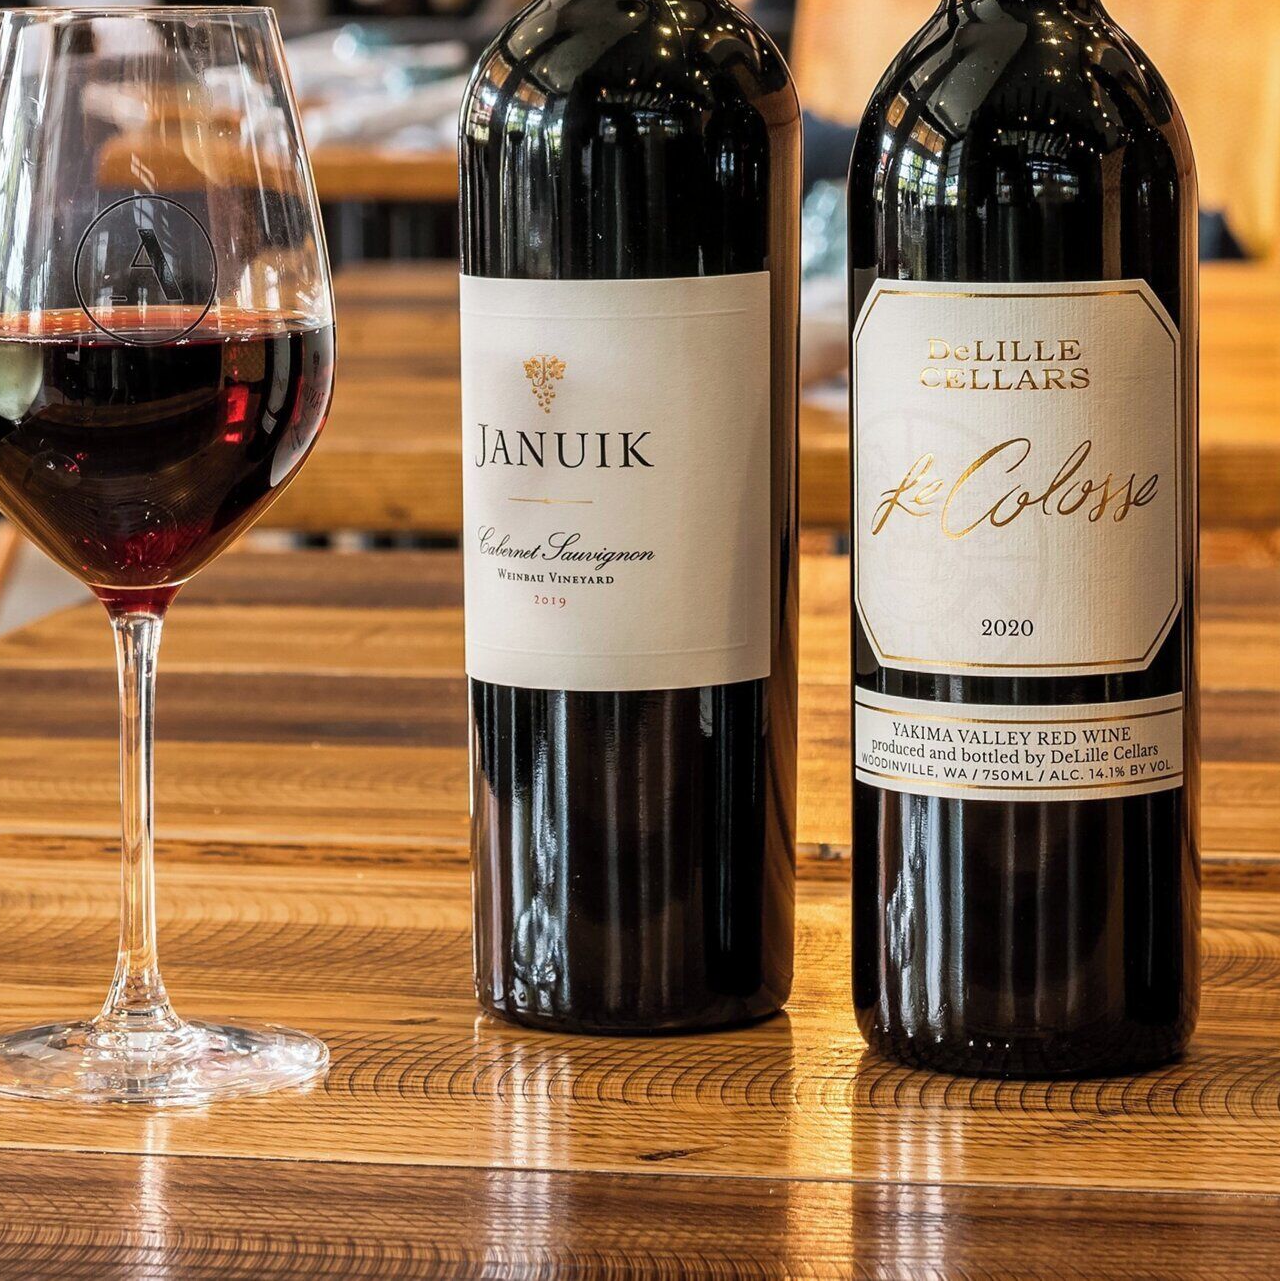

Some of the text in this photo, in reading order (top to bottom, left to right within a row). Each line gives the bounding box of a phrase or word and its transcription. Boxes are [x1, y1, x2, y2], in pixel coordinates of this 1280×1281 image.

[927, 338, 1082, 362] DeLILLE
[920, 367, 1091, 390] CELLARS
[475, 423, 655, 468] JANUIK
[941, 438, 1159, 541] Colosse
[478, 525, 656, 570] Cabernet Sauvignon
[497, 568, 615, 584] WEINBAU VINEYARD
[534, 595, 566, 609] 2019
[981, 619, 1034, 637] 2020
[892, 722, 1132, 746] YAKIMA VALLEY RED WINE
[872, 739, 1159, 767] produced and bottled by DeLille Cellars
[862, 752, 939, 778] WOODINVILLE,
[944, 767, 968, 779] WA
[982, 769, 1034, 782] 750ML
[1049, 769, 1084, 782] ALC.
[1089, 765, 1125, 780] 14.1%
[1130, 764, 1147, 776] BY
[1150, 759, 1174, 773] VOL.
